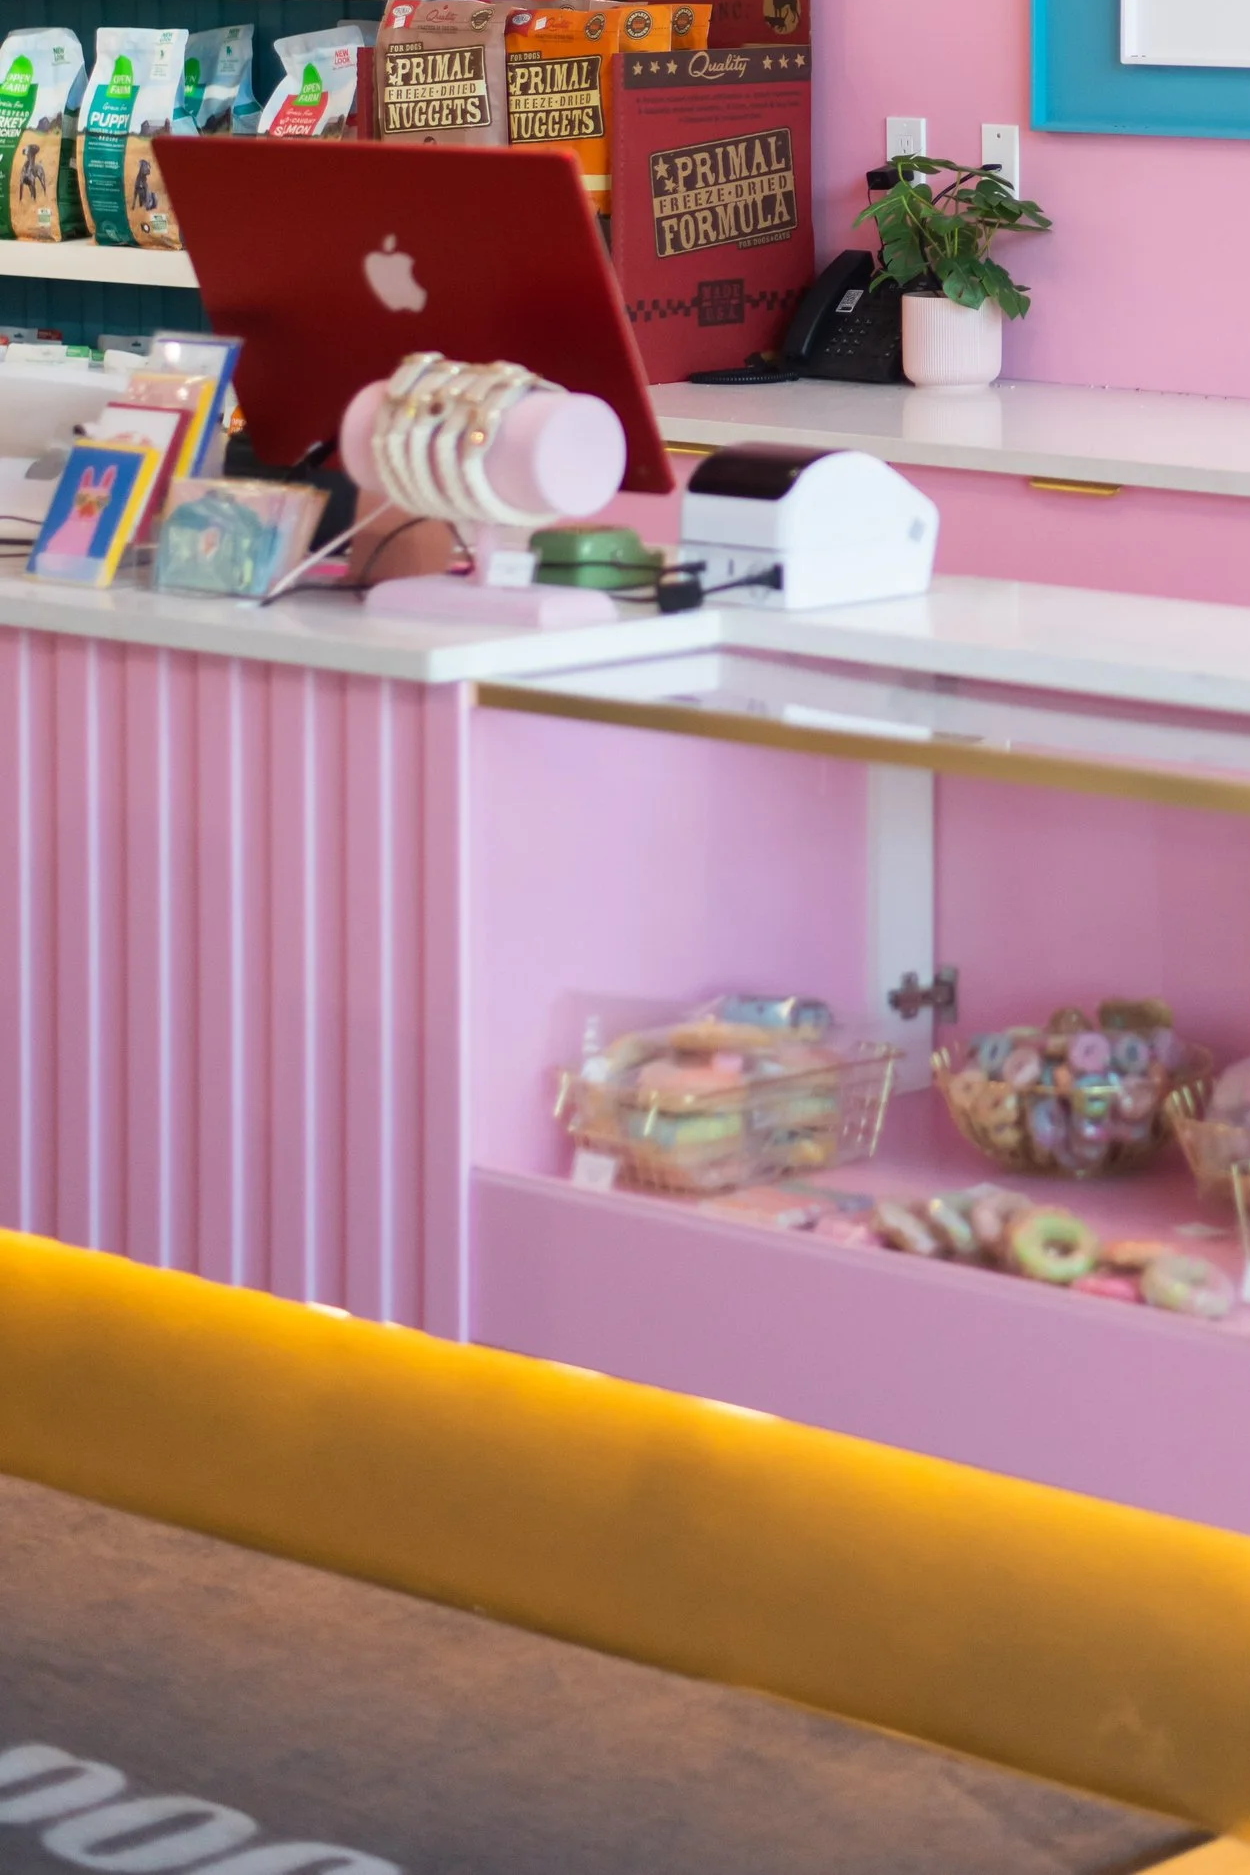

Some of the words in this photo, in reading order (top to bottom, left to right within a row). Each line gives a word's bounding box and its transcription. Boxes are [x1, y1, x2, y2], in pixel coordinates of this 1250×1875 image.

[405, 43, 422, 52] DOGS
[335, 49, 349, 59] NEW
[510, 53, 523, 62] FOR
[523, 51, 541, 61] DOGS
[335, 57, 350, 65] LOOK
[688, 51, 751, 80] Quality
[396, 52, 475, 86] PRIMAL
[6, 74, 31, 82] OPEN
[113, 75, 132, 84] OPEN
[515, 61, 591, 95] PRIMAL
[2, 84, 29, 93] FARM
[302, 83, 321, 93] OPEN
[298, 93, 320, 102] FARM
[388, 98, 482, 129] NUGGETS
[90, 111, 130, 128] PUPPY
[510, 107, 595, 139] NUGGETS
[674, 135, 786, 193] PRIMAL
[662, 190, 791, 256] FORMULA
[738, 240, 752, 249] FOR
